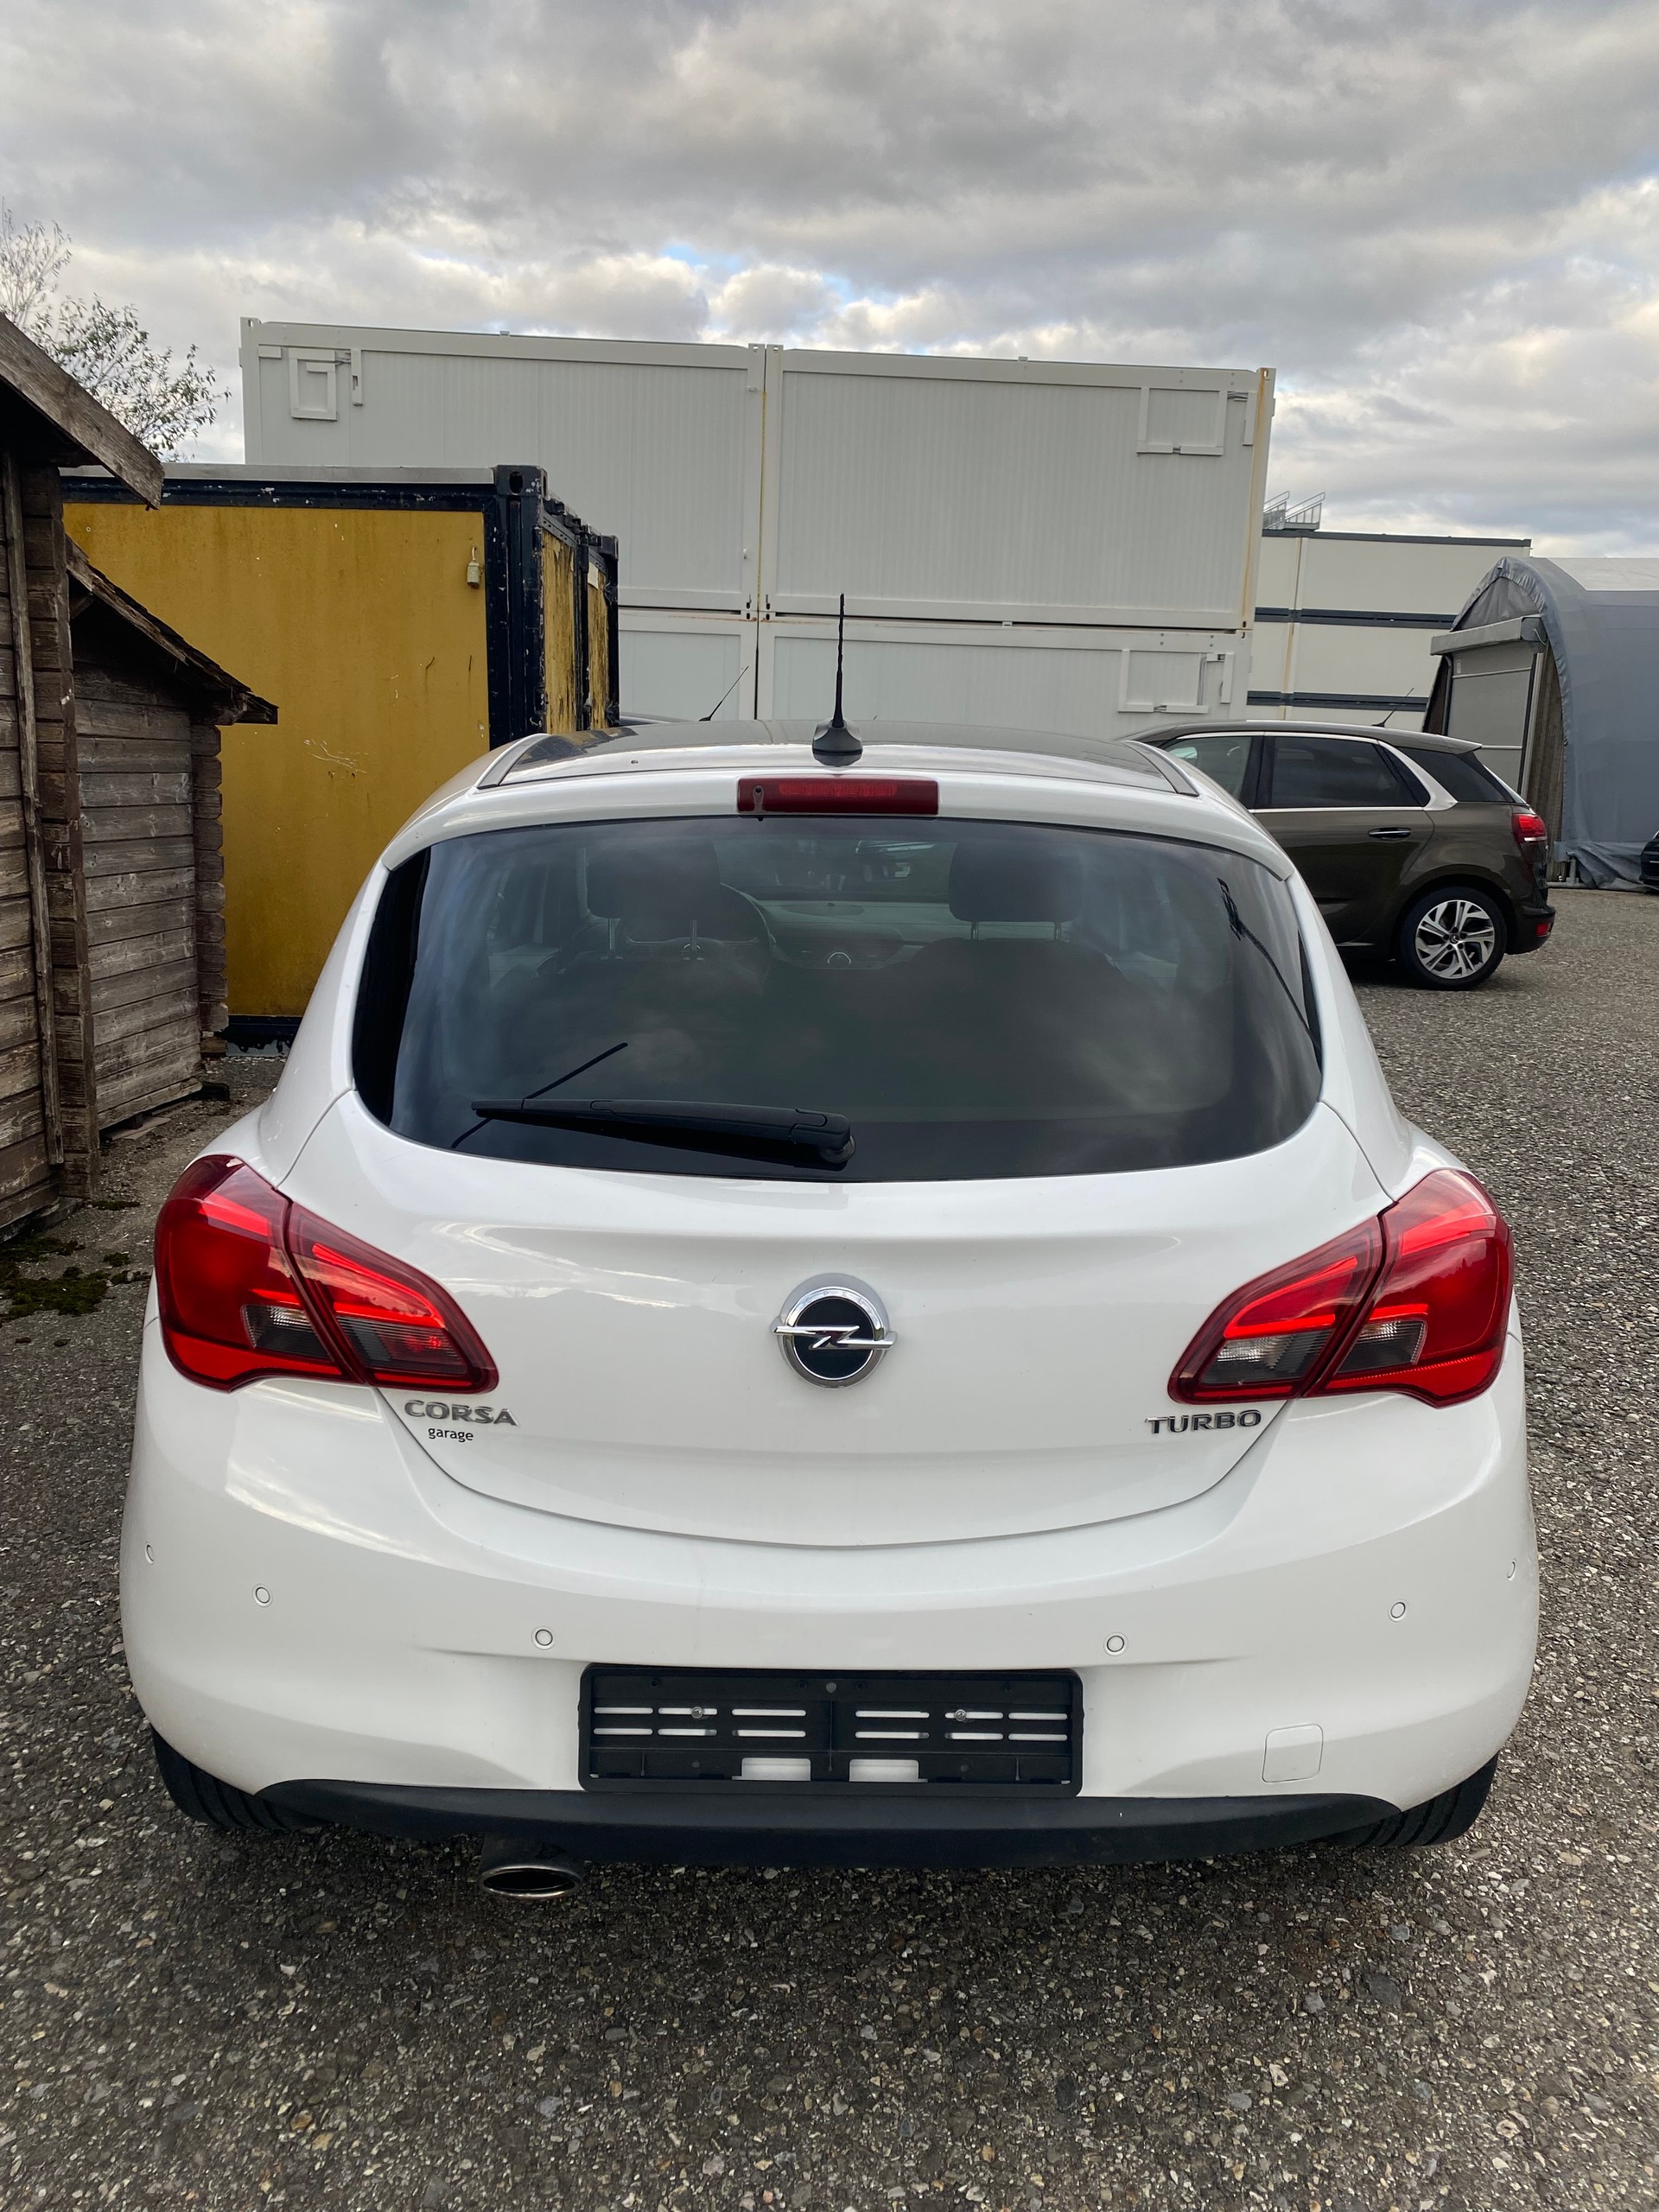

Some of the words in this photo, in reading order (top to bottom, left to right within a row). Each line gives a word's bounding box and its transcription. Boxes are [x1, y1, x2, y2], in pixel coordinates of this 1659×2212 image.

[805, 1290, 862, 1306] OPEL
[404, 1399, 518, 1427] CORSA
[1144, 1409, 1262, 1434] TURBO
[428, 1427, 474, 1442] garage
